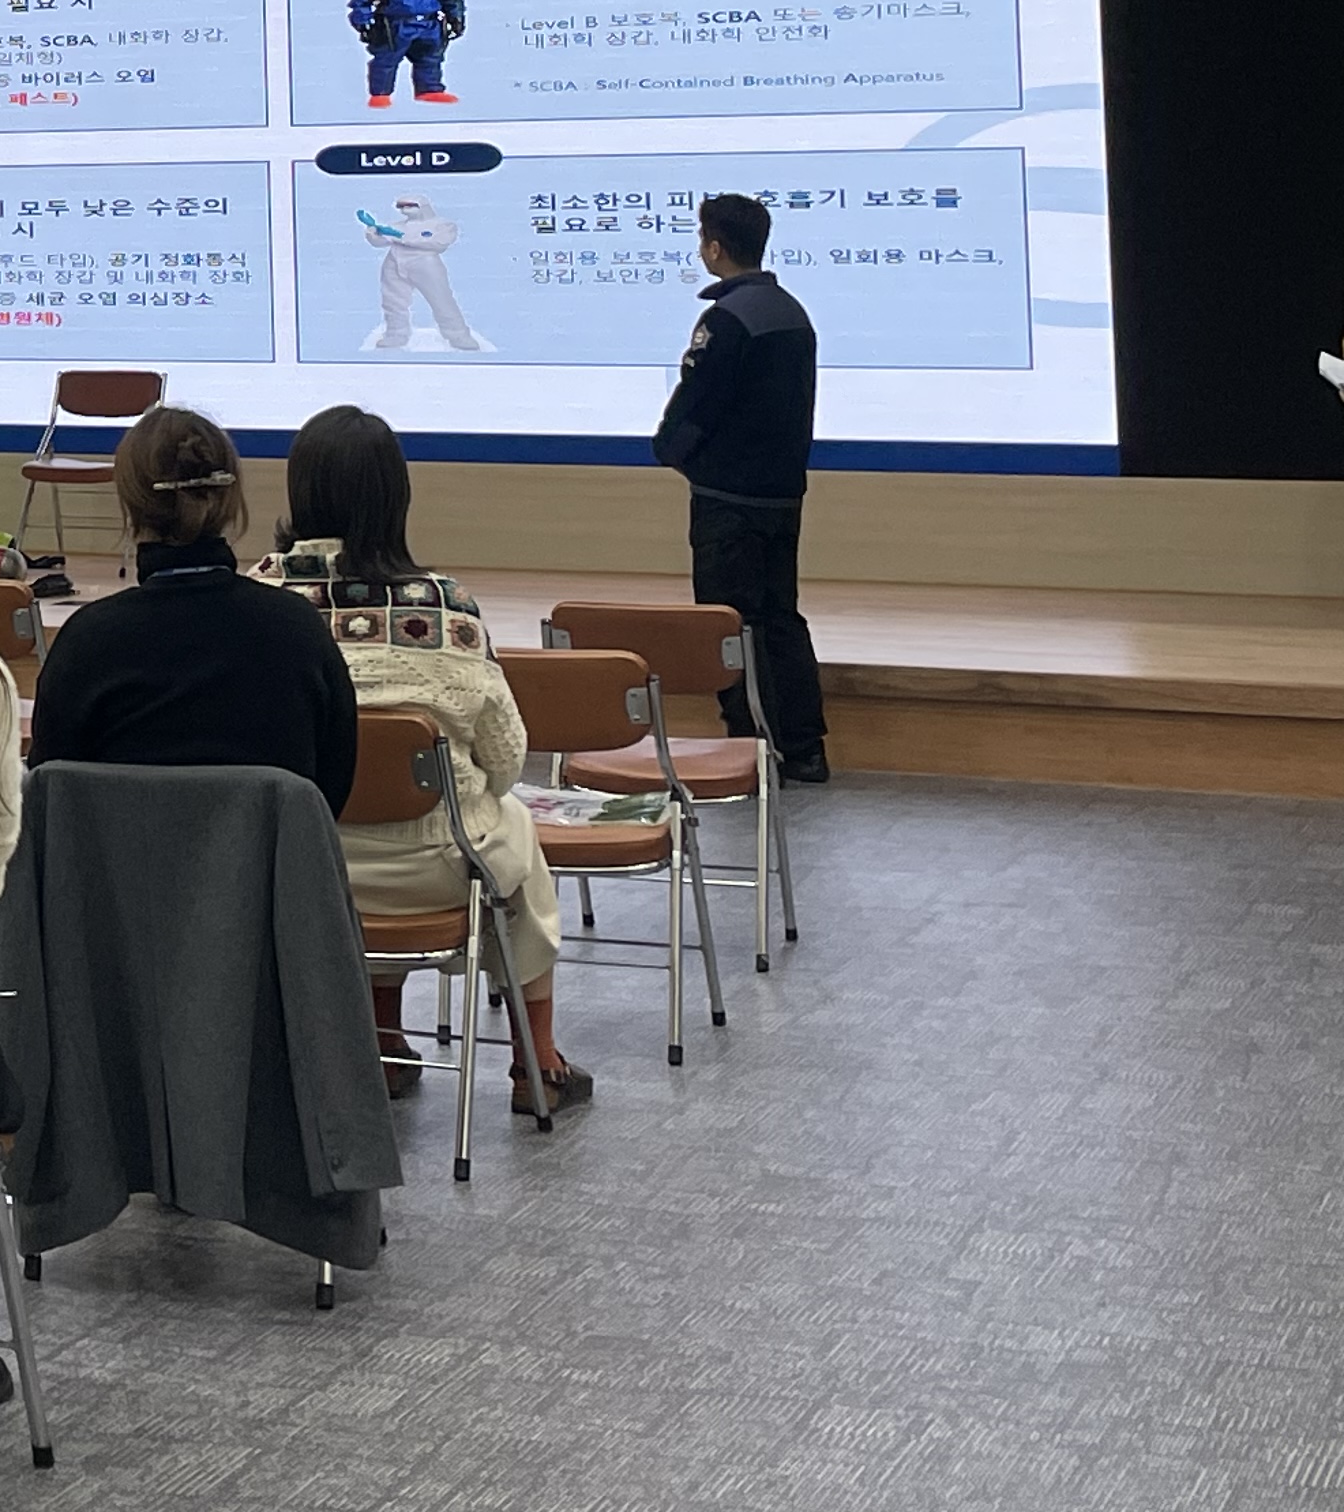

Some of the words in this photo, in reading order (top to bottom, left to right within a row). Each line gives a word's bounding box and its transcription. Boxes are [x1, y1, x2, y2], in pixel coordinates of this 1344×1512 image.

[520, 15, 575, 31] Level
[584, 15, 599, 30] B
[696, 9, 763, 24] SCBA
[772, 6, 823, 23] 또는
[832, 1, 971, 21] 송기마스크,
[755, 24, 831, 43] 안전화
[21, 69, 106, 87] 바이러스
[114, 67, 156, 84] 오염
[595, 75, 735, 91] Self-Contained
[742, 72, 836, 88] Breathing
[842, 71, 946, 87] Apparatus
[8, 90, 79, 107] 페스트)
[360, 150, 421, 167] Level
[431, 151, 451, 166] D
[17, 198, 71, 218] 모두
[82, 197, 136, 218] 낮은
[146, 196, 229, 217] 수준의
[528, 191, 652, 212] 최소한의
[753, 188, 847, 209] 호흡기
[862, 187, 963, 209] 보호를
[11, 220, 35, 239] 시
[530, 214, 622, 234] 필요로
[635, 213, 698, 234] 하는
[107, 251, 151, 268] 공기
[528, 249, 600, 267] 일회용
[828, 248, 907, 266] 일회용
[918, 248, 1004, 266] 마스크,
[54, 268, 96, 286] 장갑
[530, 268, 583, 286] 장갑,
[592, 267, 666, 285] 보안경
[677, 267, 701, 285] 등
[25, 290, 68, 307] 세균
[75, 290, 117, 307] 오염
[125, 290, 216, 307] 의심장소
